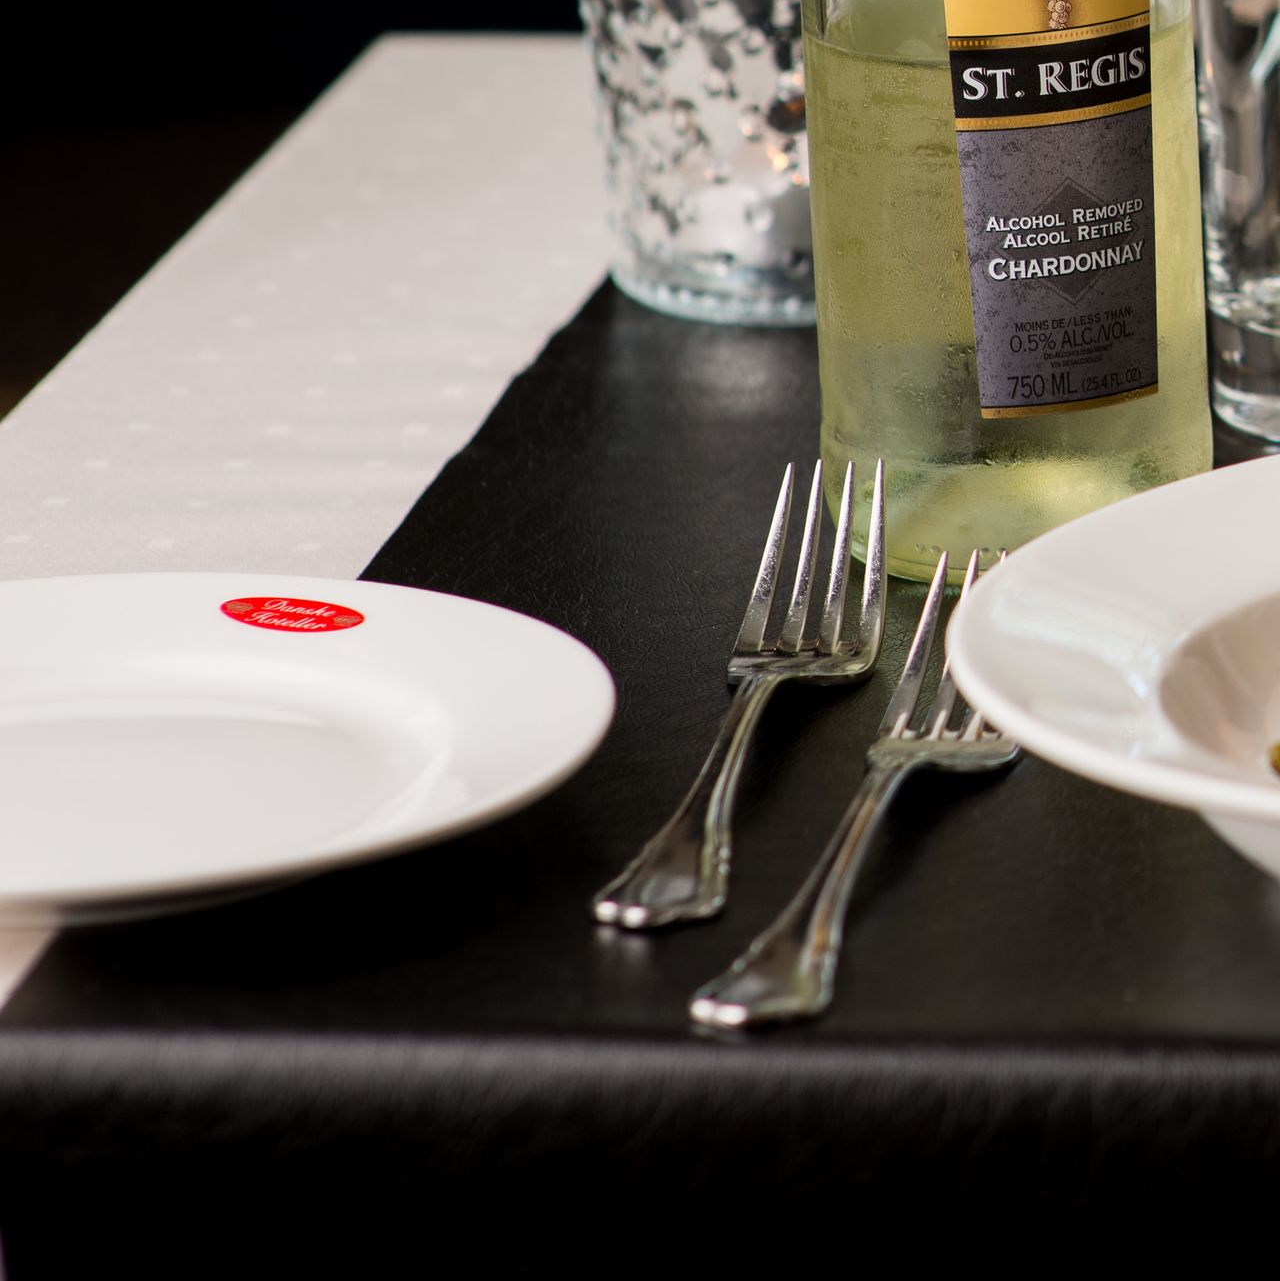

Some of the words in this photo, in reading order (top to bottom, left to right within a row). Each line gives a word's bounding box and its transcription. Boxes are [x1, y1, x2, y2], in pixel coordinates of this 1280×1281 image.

[962, 67, 1025, 100] ST.
[1038, 46, 1146, 96] REGIS
[986, 213, 1066, 232] ALCOHOL
[1072, 198, 1143, 224] REMOVED
[1003, 230, 1071, 249] ALCOOL
[1077, 215, 1133, 241] RETIRÉ
[988, 239, 1145, 280] CHARDONNAY
[1015, 320, 1050, 332] MOINS
[1104, 306, 1132, 321] THAN
[1009, 332, 1057, 354] 0.5%
[1007, 374, 1046, 400] 750
[1051, 371, 1079, 396] ML
[244, 611, 328, 630] Hoteller
[261, 598, 337, 618] Danske
